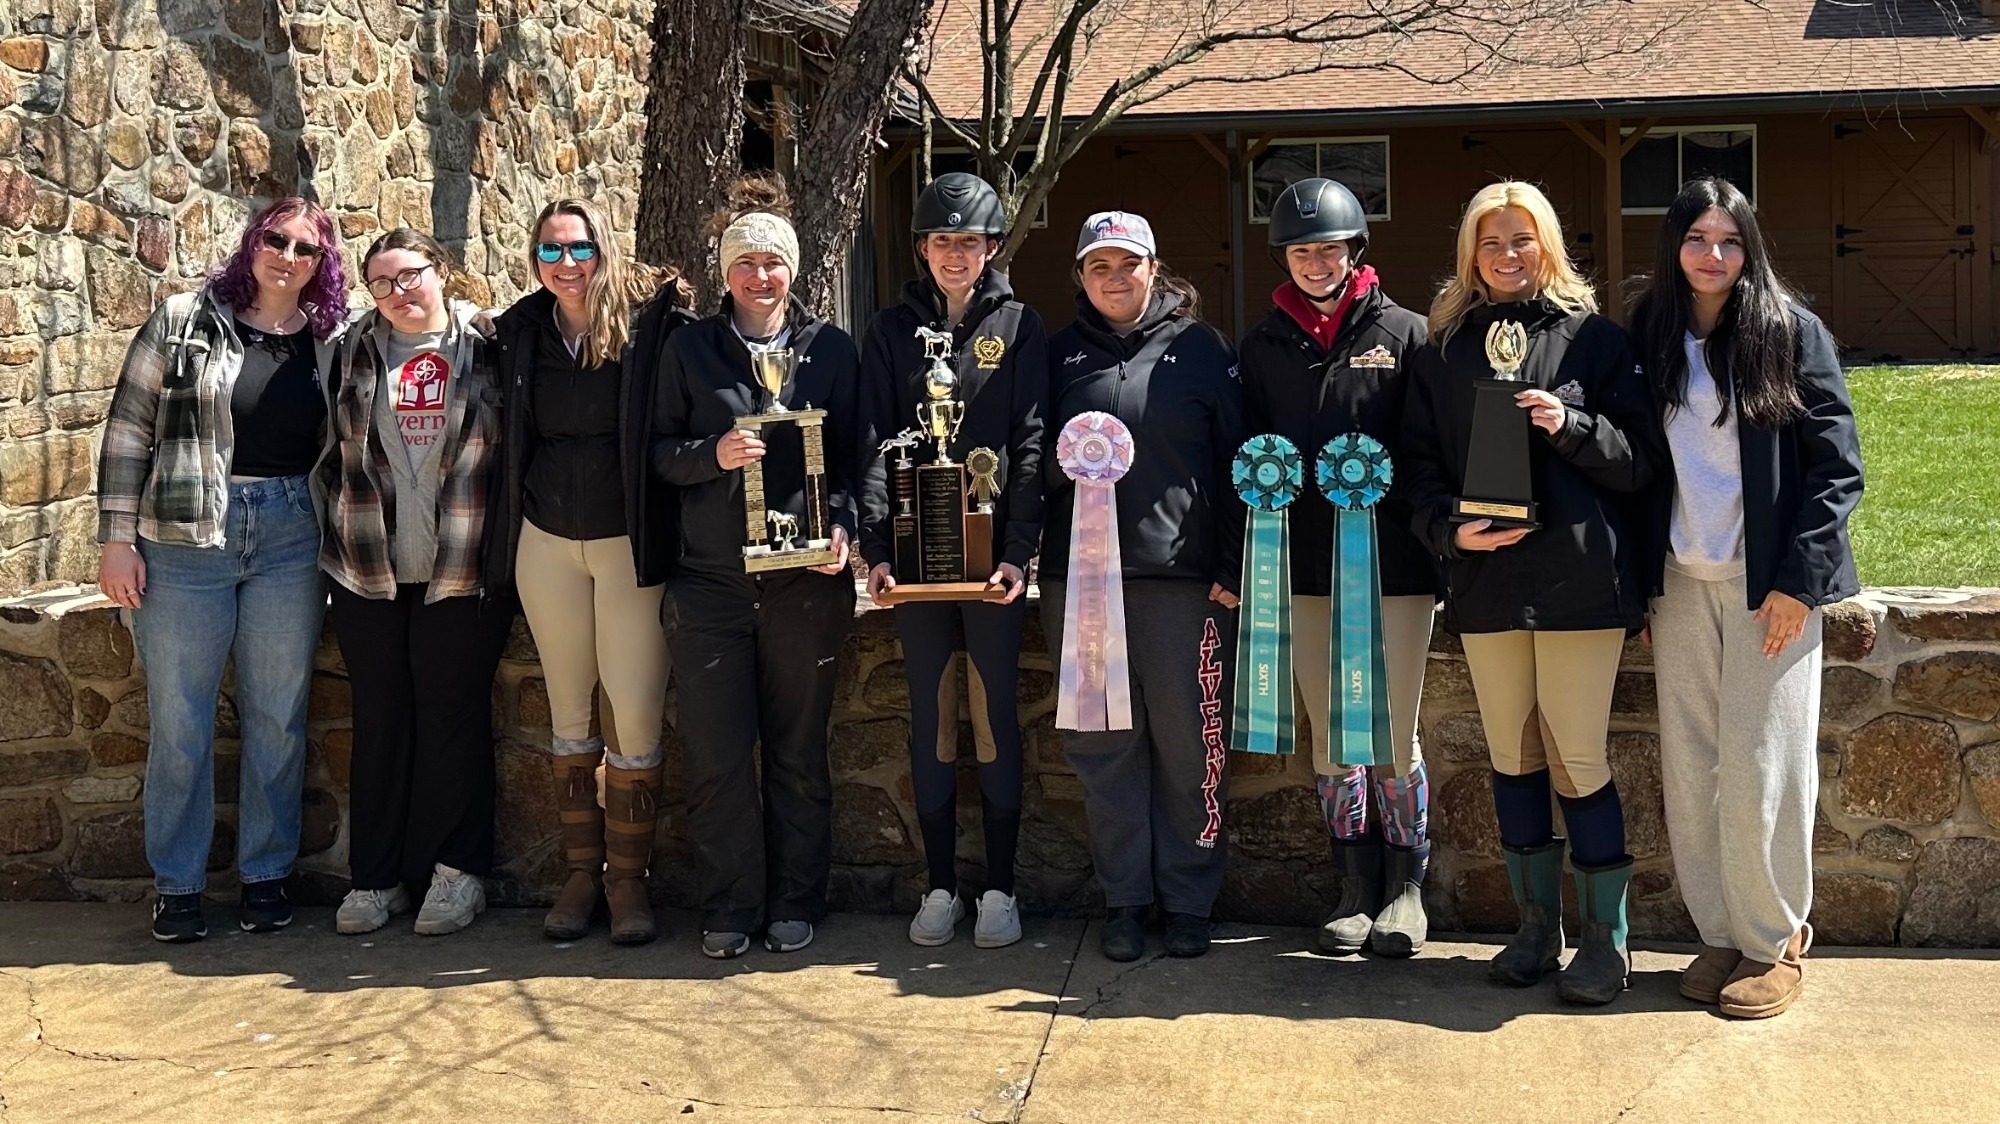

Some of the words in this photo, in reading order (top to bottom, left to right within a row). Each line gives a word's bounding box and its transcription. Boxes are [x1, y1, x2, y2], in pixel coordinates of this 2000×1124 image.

[1258, 663, 1269, 696] SIXTH
[1351, 669, 1363, 704] SIXTH
[1199, 617, 1225, 842] ALVERNIA
